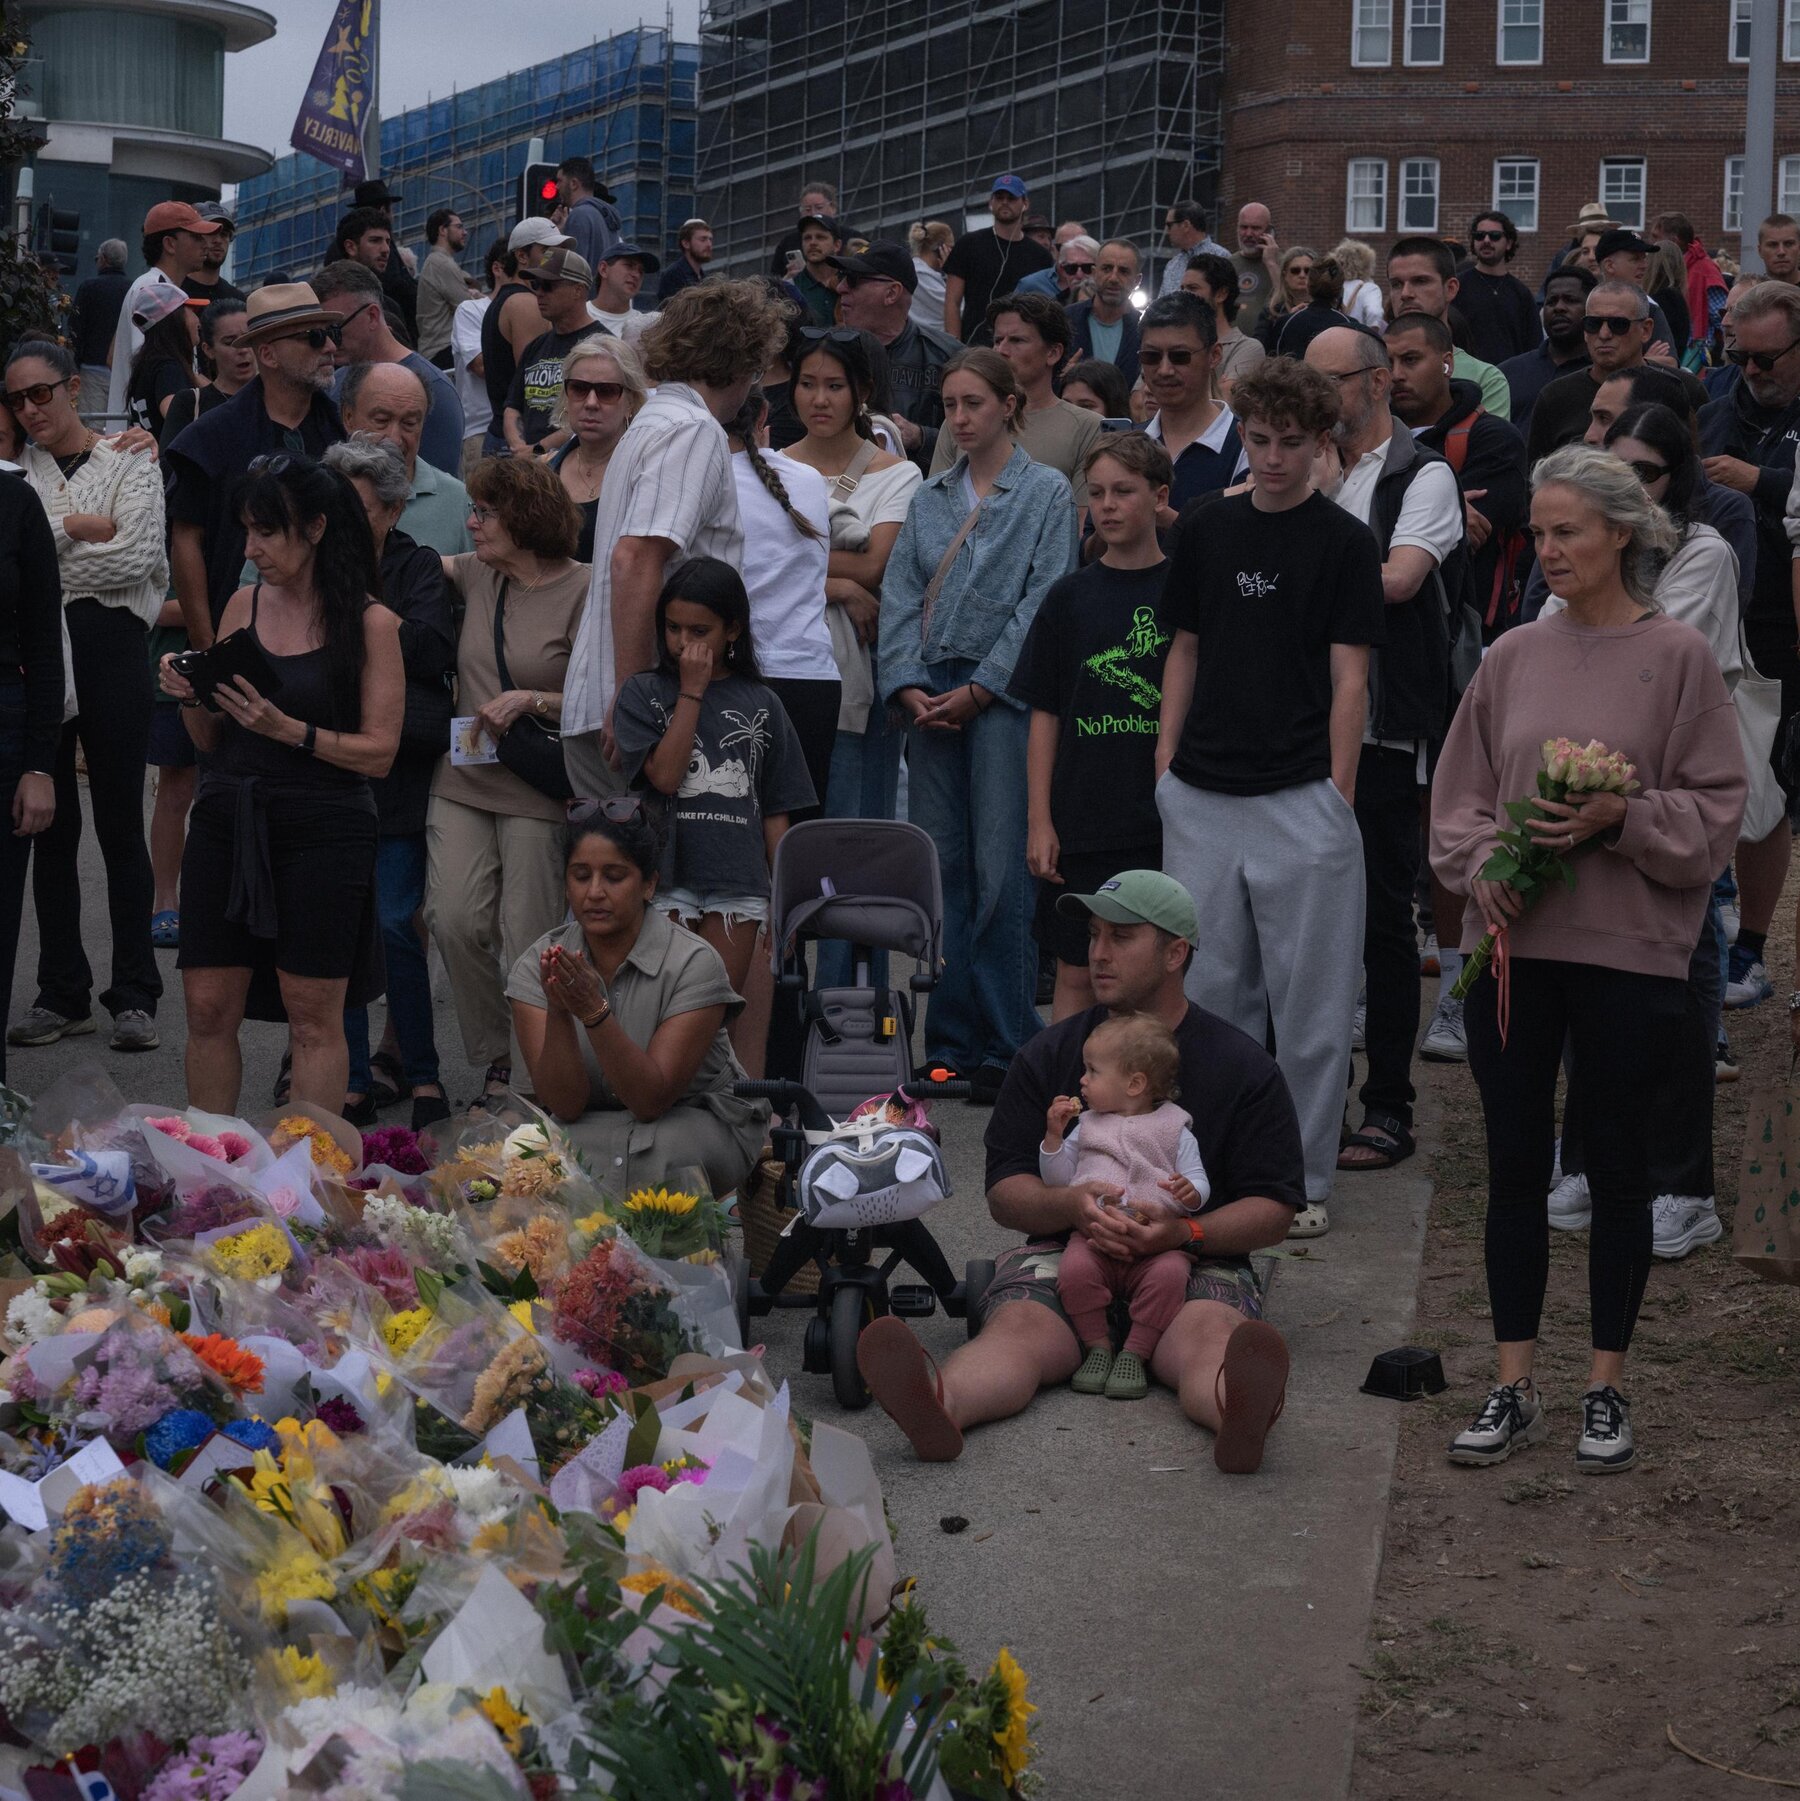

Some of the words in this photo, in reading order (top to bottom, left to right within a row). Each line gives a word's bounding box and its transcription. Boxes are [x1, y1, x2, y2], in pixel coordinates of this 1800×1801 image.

[697, 811, 707, 820] IT
[706, 812, 713, 821] A
[713, 812, 735, 823] CHILL
[735, 815, 748, 825] DAY
